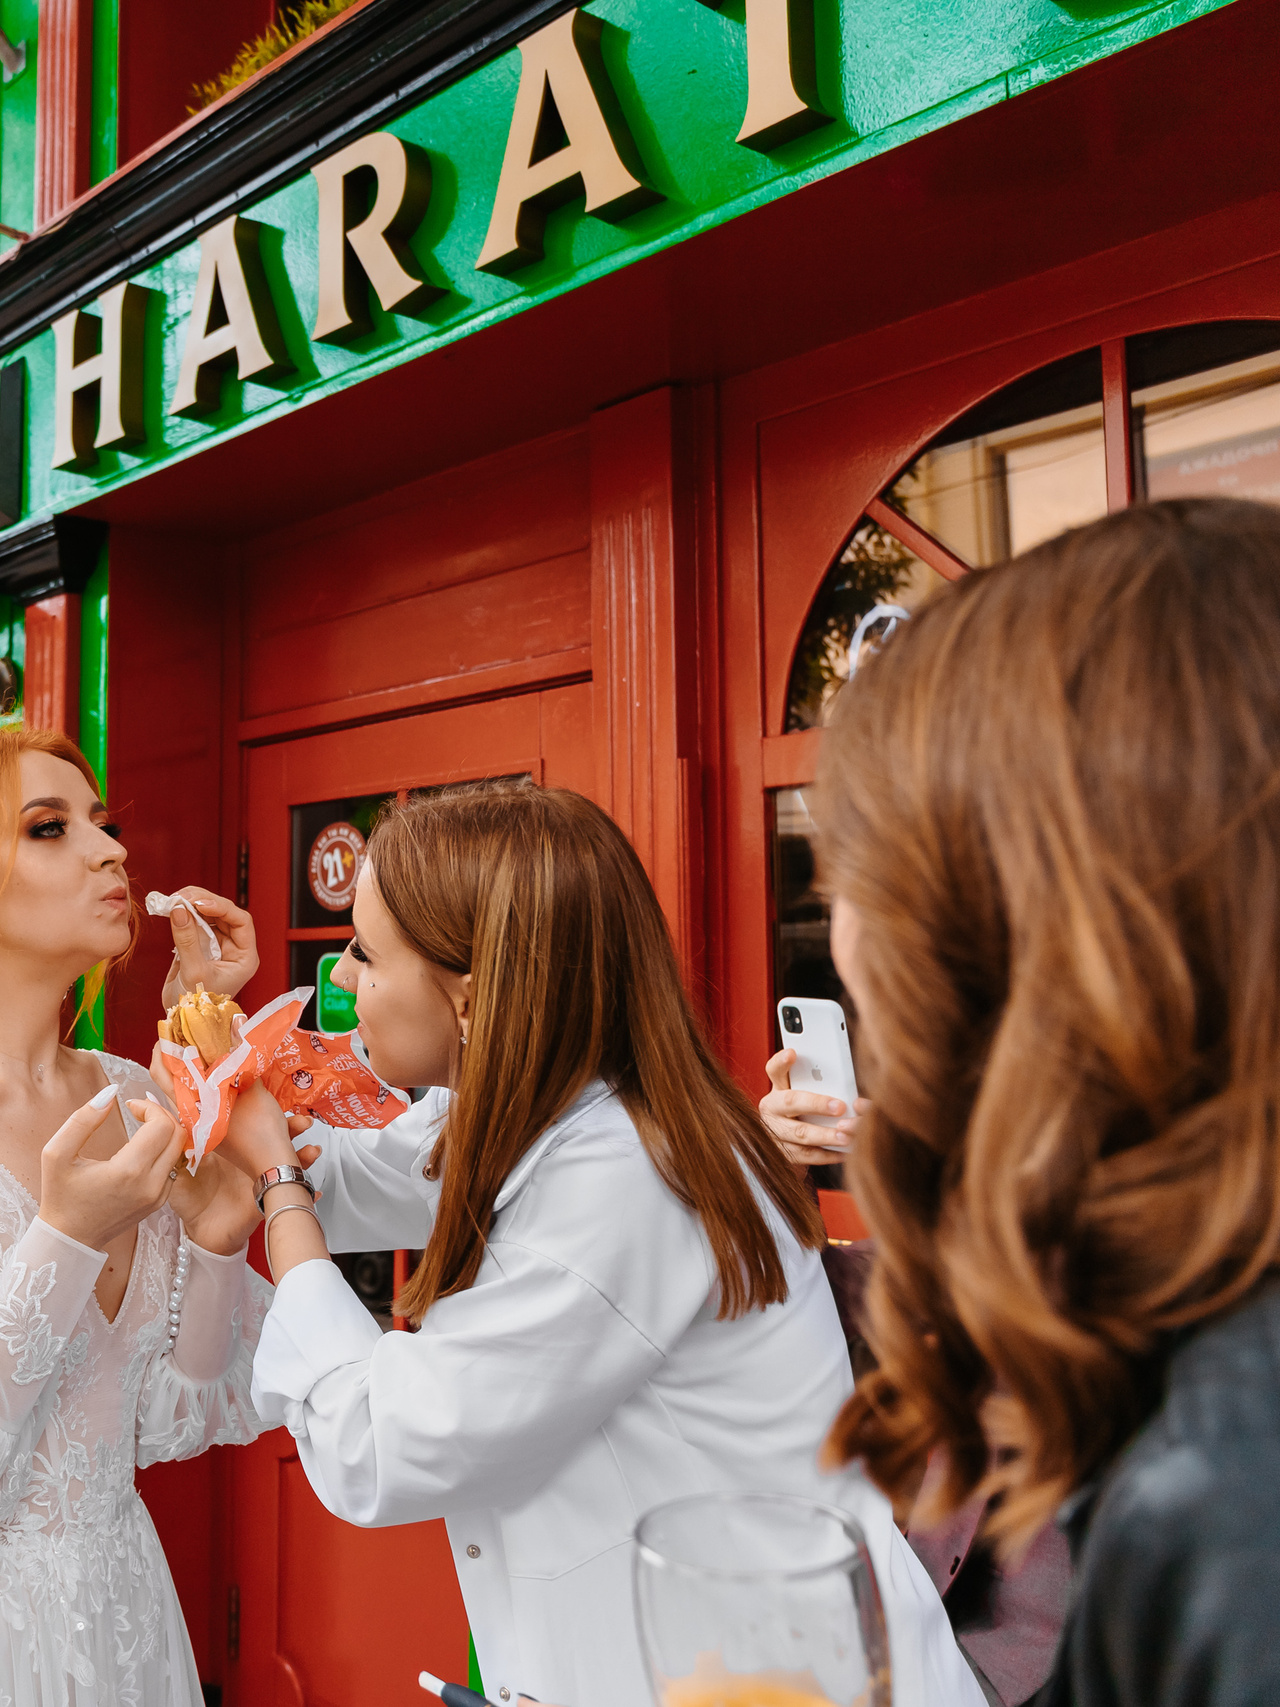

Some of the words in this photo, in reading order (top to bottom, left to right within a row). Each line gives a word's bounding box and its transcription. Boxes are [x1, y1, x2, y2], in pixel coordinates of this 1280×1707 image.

[281, 1054, 302, 1070] KFC
[344, 1093, 370, 1117] ЛЮК
[325, 1112, 345, 1125] KFC
